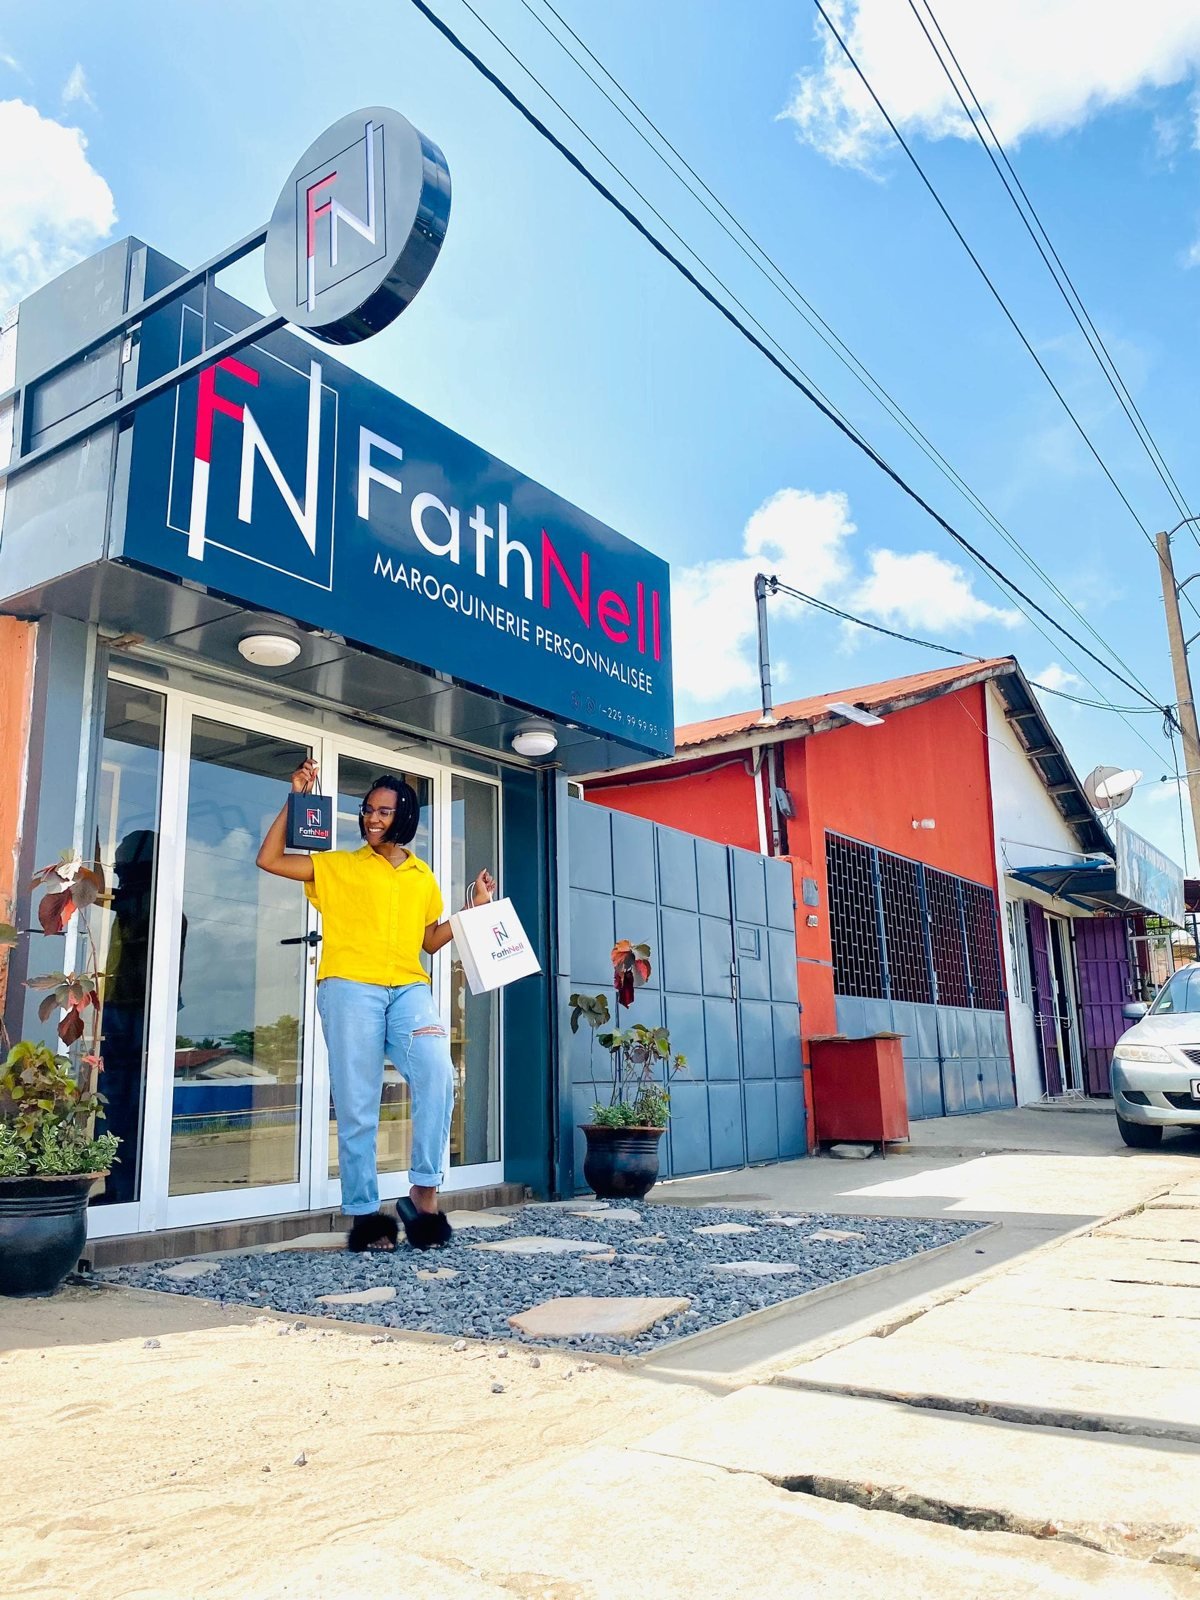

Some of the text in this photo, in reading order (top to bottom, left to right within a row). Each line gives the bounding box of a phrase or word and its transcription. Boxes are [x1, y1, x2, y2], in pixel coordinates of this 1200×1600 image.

[306, 120, 375, 313] FN
[188, 356, 322, 561] FN
[357, 425, 661, 662] FathNell
[373, 552, 653, 694] MAROQUINERIE PERSONNALISÉE
[299, 827, 328, 837] FathNell
[491, 942, 524, 960] FathNell
